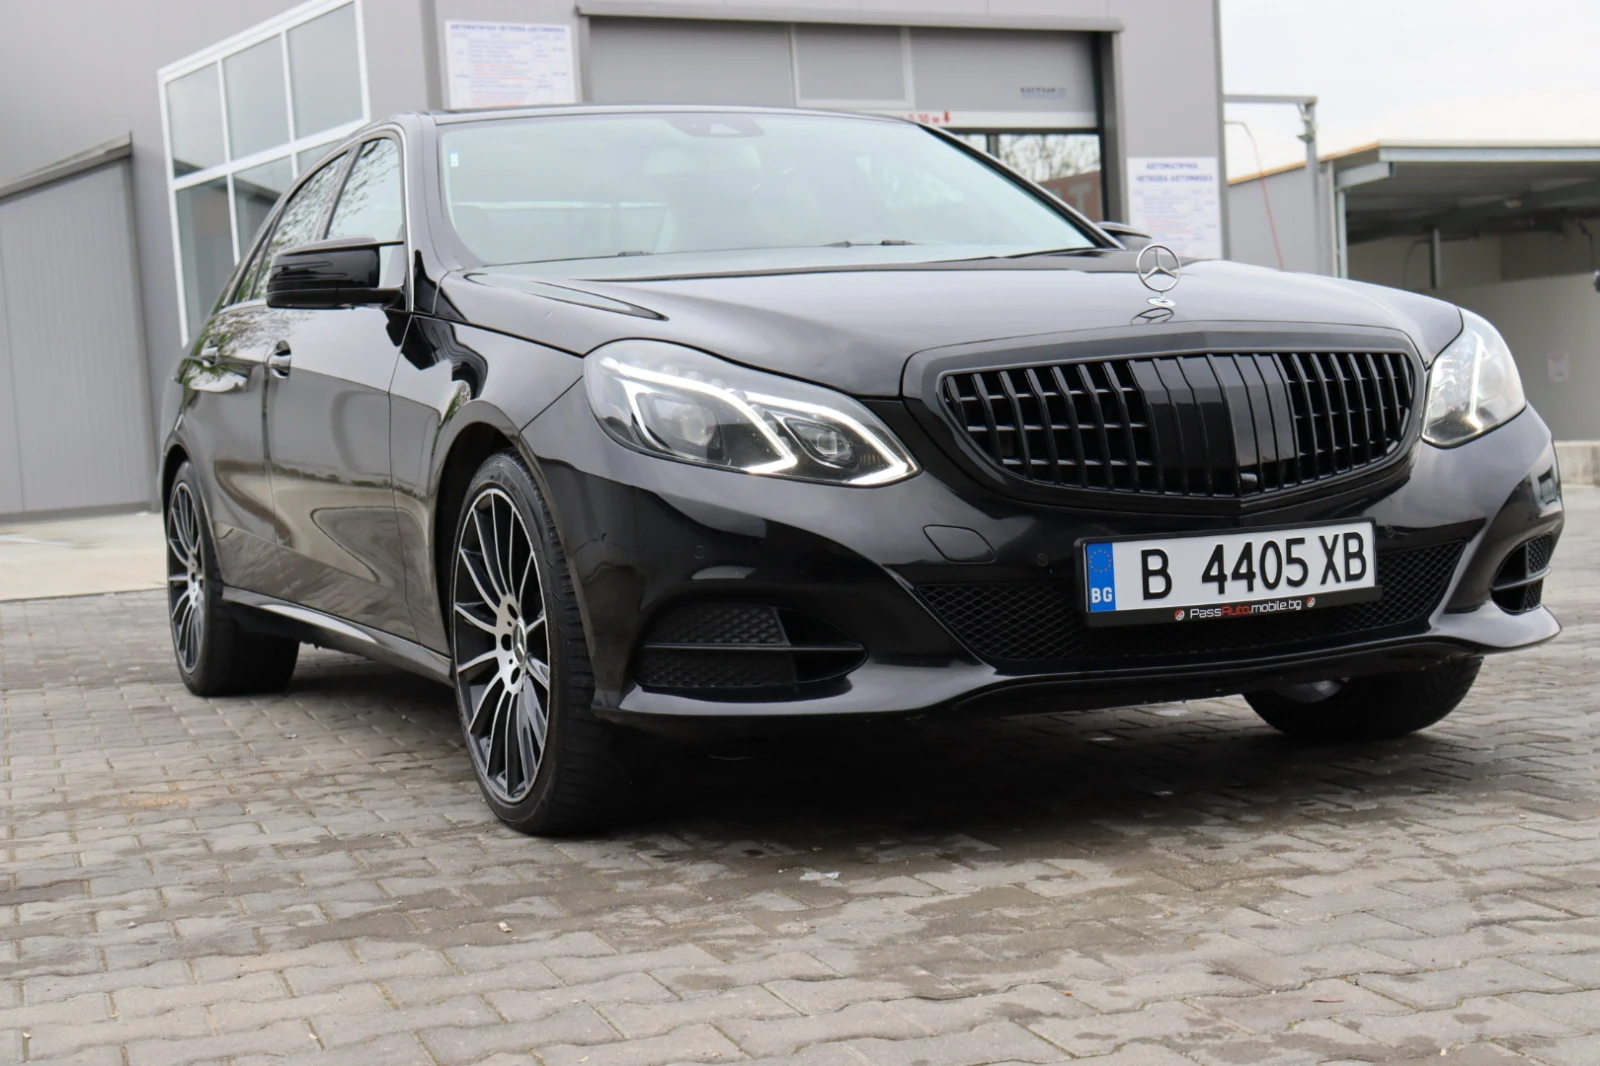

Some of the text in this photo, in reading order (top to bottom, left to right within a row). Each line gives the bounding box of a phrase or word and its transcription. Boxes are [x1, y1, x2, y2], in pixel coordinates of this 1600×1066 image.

[1140, 531, 1368, 601] B 4405 XB
[1091, 587, 1113, 604] BG
[1190, 599, 1302, 619] PassAuto.mobile.bg
